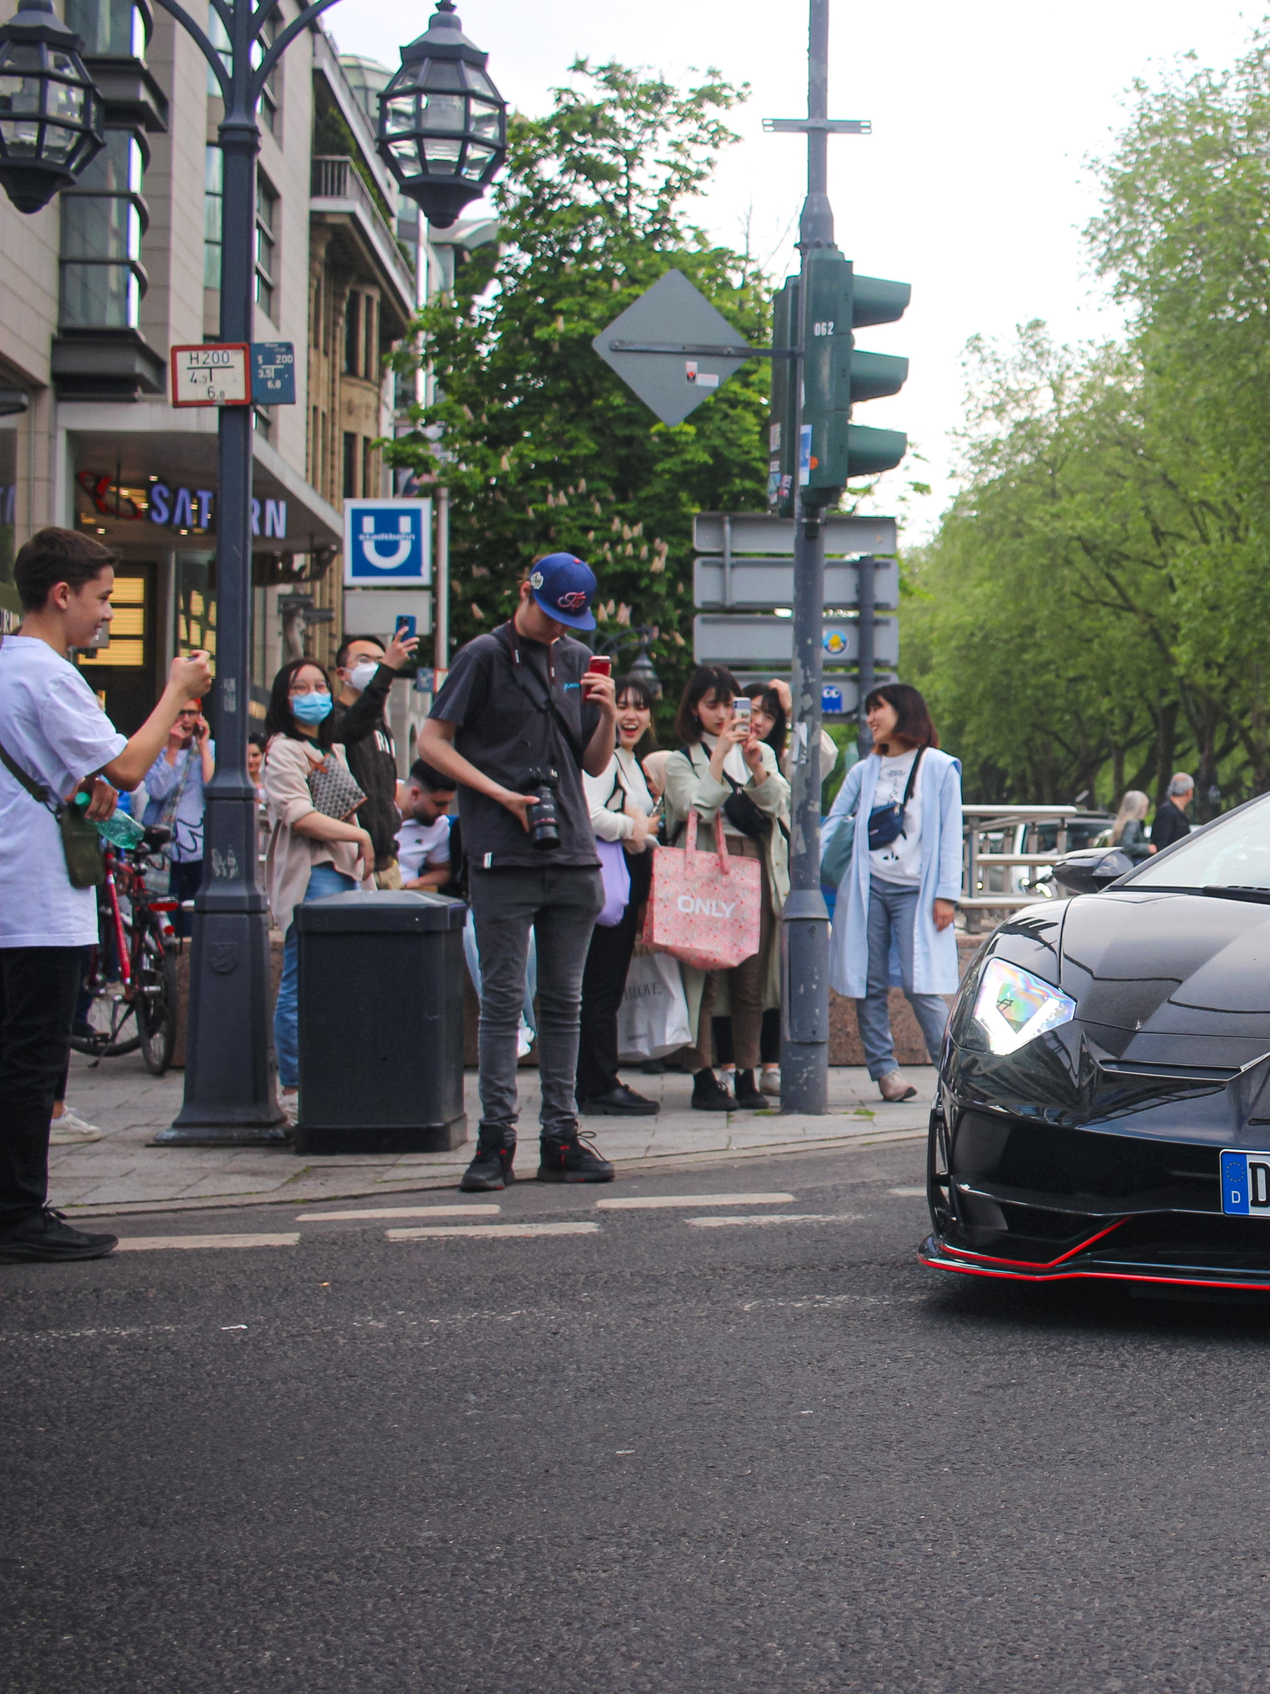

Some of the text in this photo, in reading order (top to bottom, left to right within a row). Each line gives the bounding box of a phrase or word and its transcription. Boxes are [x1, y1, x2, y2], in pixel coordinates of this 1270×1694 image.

[189, 350, 230, 365] H200
[275, 354, 293, 365] 200
[151, 483, 287, 539] SATRN
[362, 515, 412, 570] U
[677, 896, 737, 918] ONLY
[1231, 1190, 1241, 1204] D
